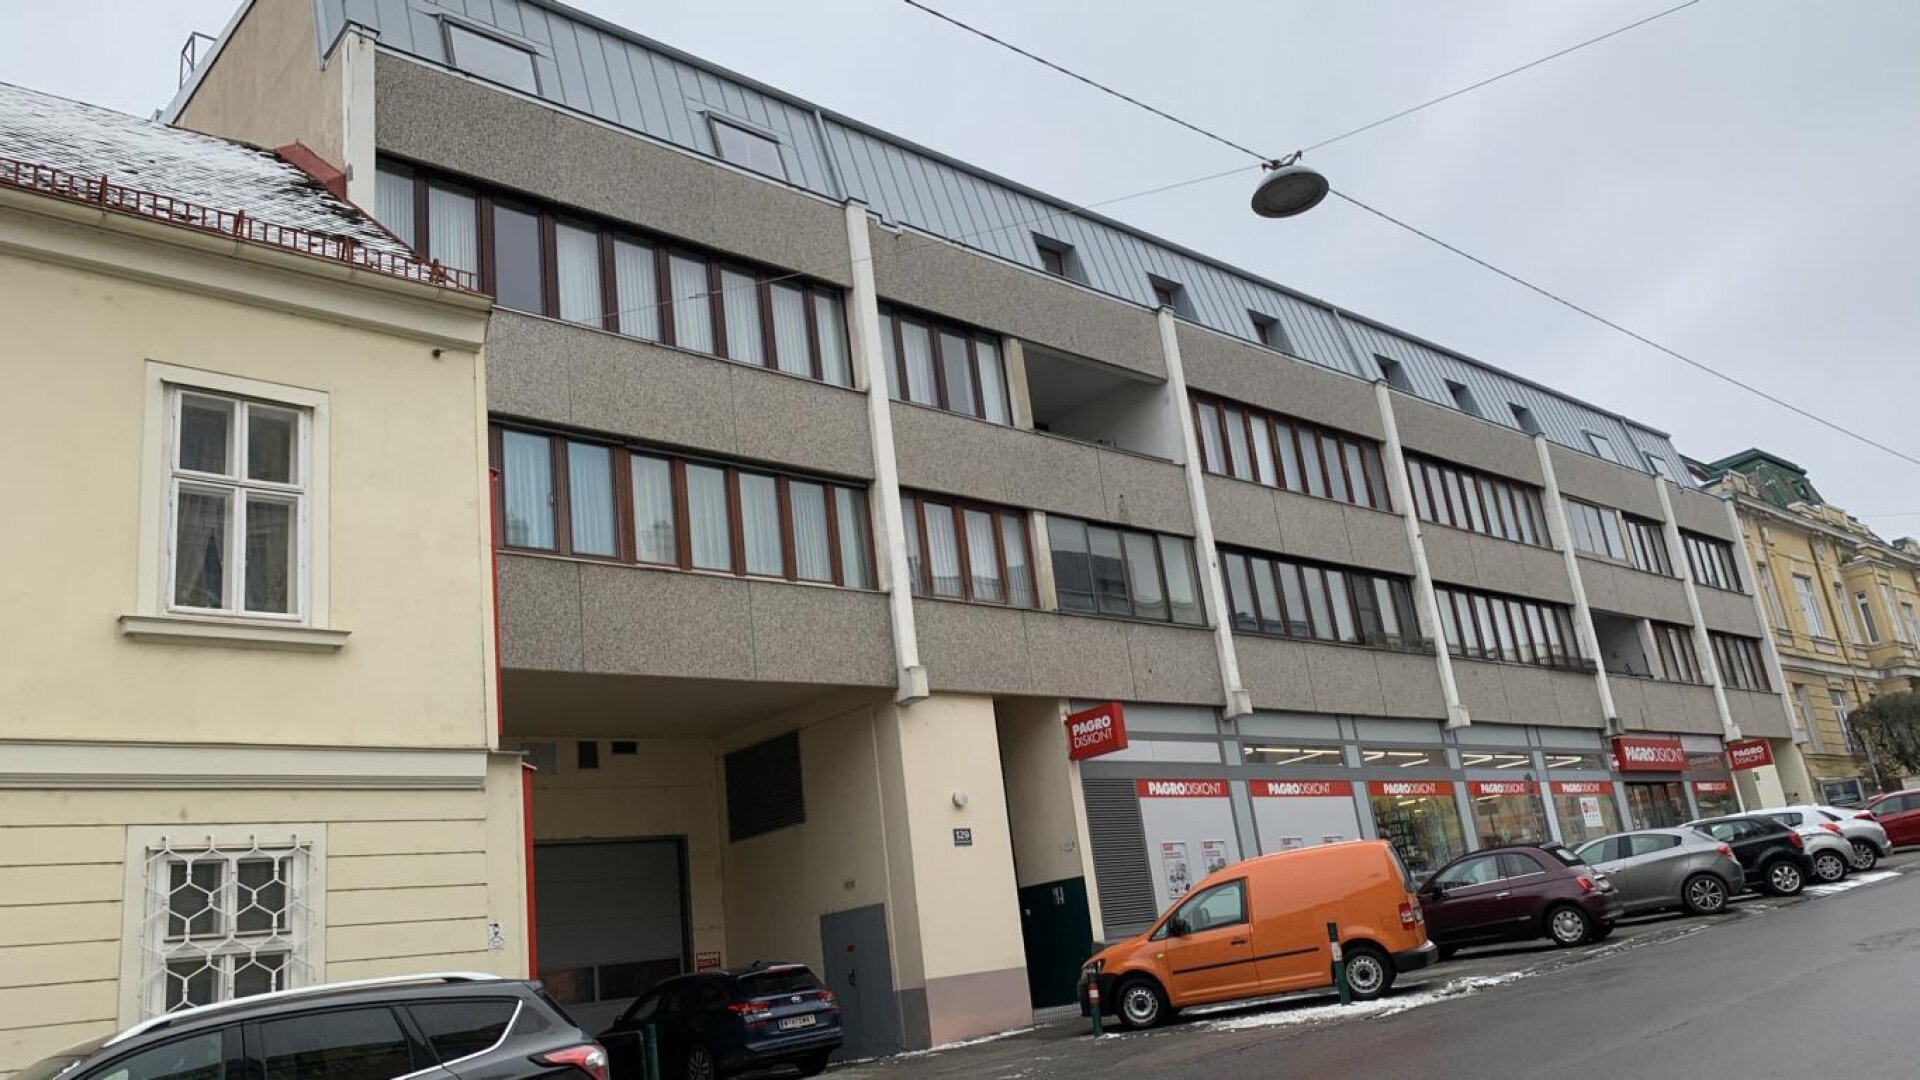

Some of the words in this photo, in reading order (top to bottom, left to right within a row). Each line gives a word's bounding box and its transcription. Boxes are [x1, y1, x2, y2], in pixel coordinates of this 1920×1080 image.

[1072, 715, 1112, 737] PAGRO
[1074, 728, 1113, 749] DISKONT
[1732, 746, 1765, 759] PAGRO
